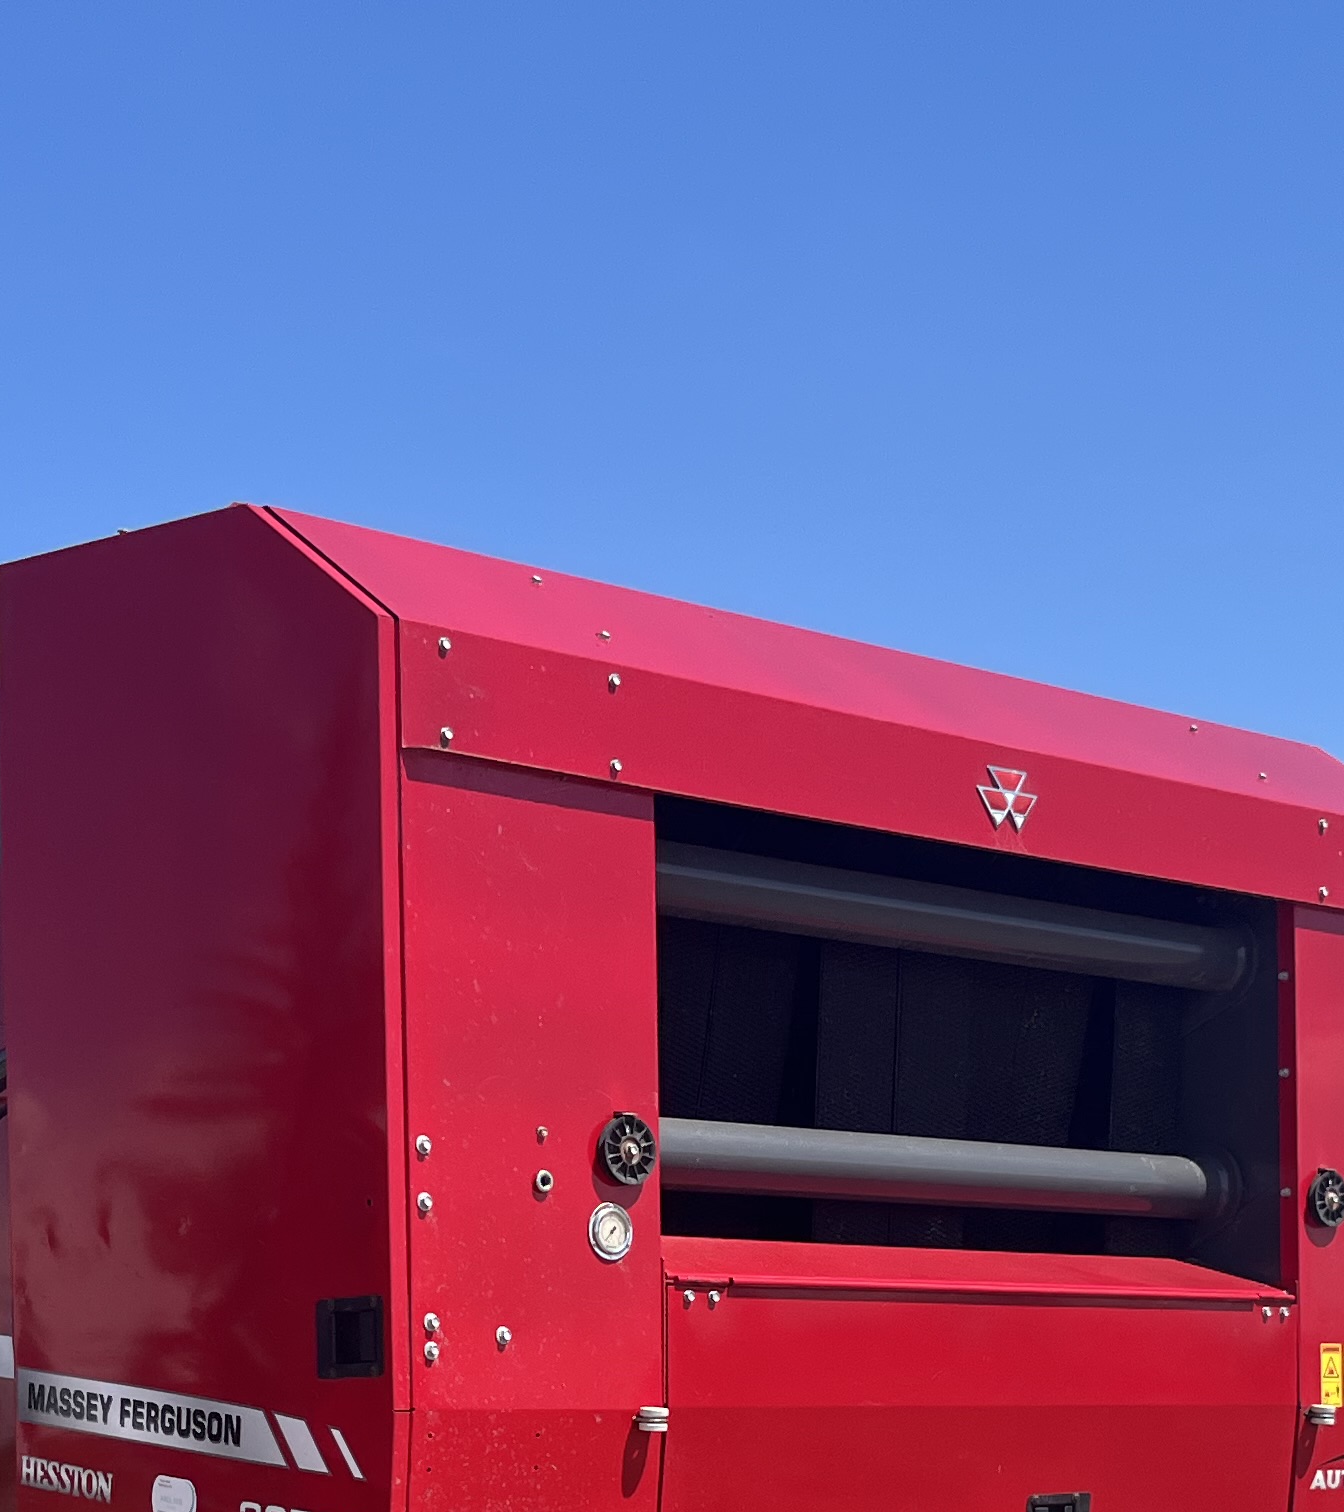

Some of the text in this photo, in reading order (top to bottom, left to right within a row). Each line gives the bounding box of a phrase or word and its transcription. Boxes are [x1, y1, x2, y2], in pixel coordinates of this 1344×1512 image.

[27, 1382, 242, 1447] MASSEY FERGUSON
[21, 1455, 113, 1504] HESSTON
